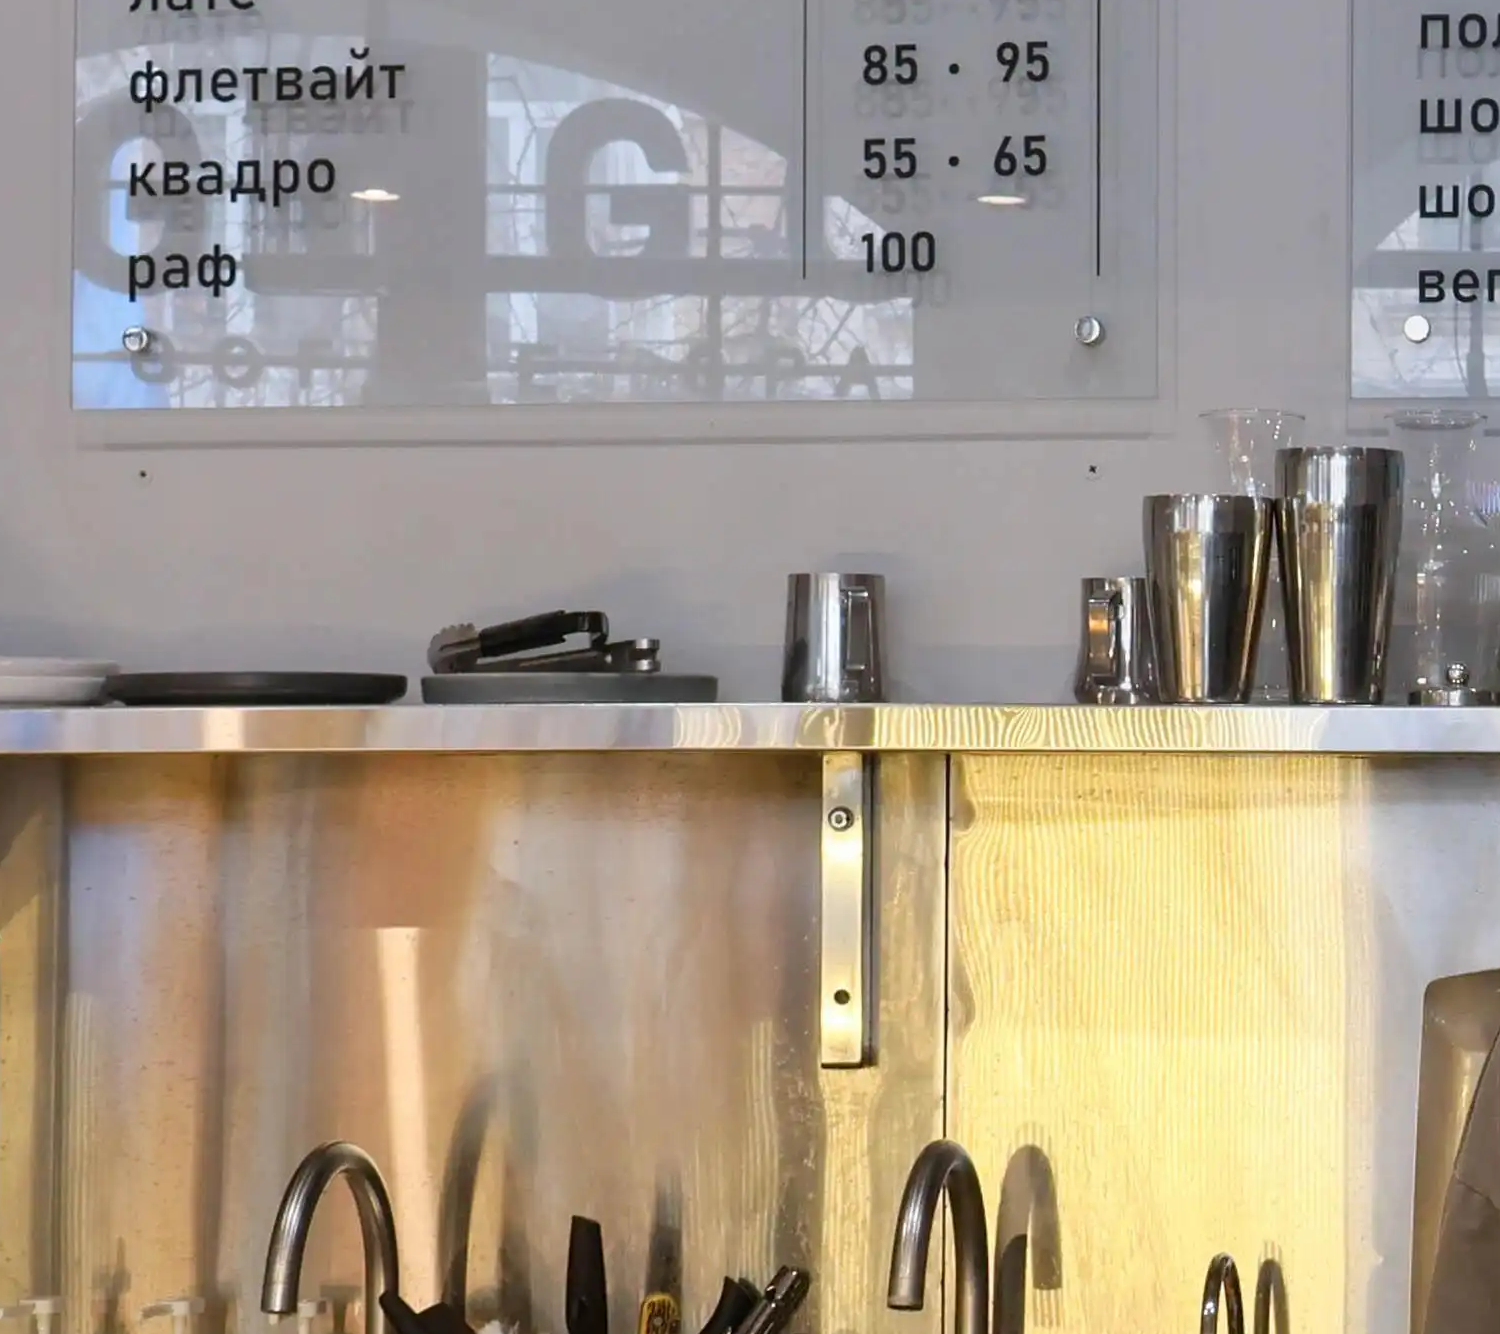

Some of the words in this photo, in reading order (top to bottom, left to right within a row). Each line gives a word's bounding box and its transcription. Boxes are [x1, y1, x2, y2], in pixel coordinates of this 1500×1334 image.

[130, 47, 406, 114] флетвайт
[130, 158, 336, 208] квадро
[864, 137, 917, 180] 55
[994, 135, 1047, 177] 65
[128, 244, 237, 303] раф
